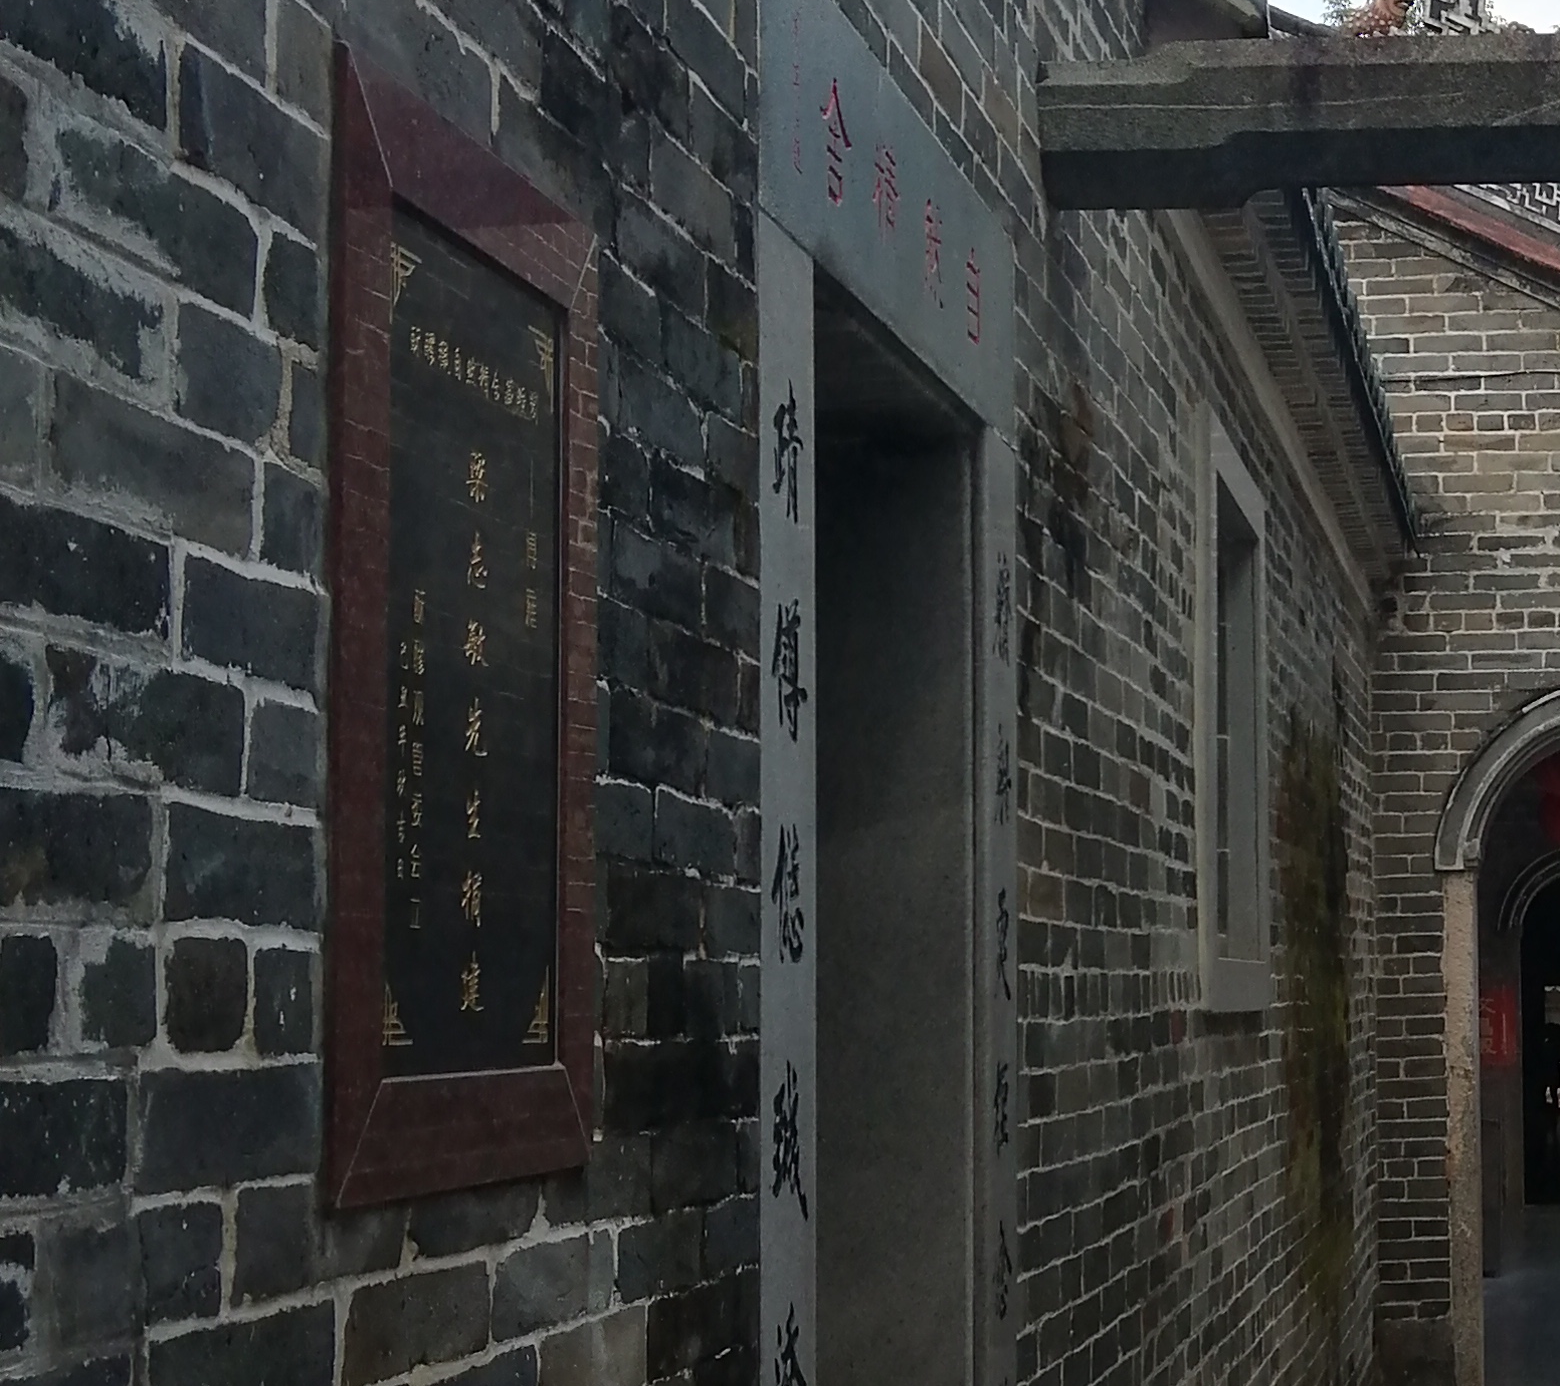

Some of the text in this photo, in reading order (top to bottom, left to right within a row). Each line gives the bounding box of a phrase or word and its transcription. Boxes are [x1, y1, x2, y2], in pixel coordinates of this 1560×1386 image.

[459, 452, 489, 1013] 梁志敏先生捐建
